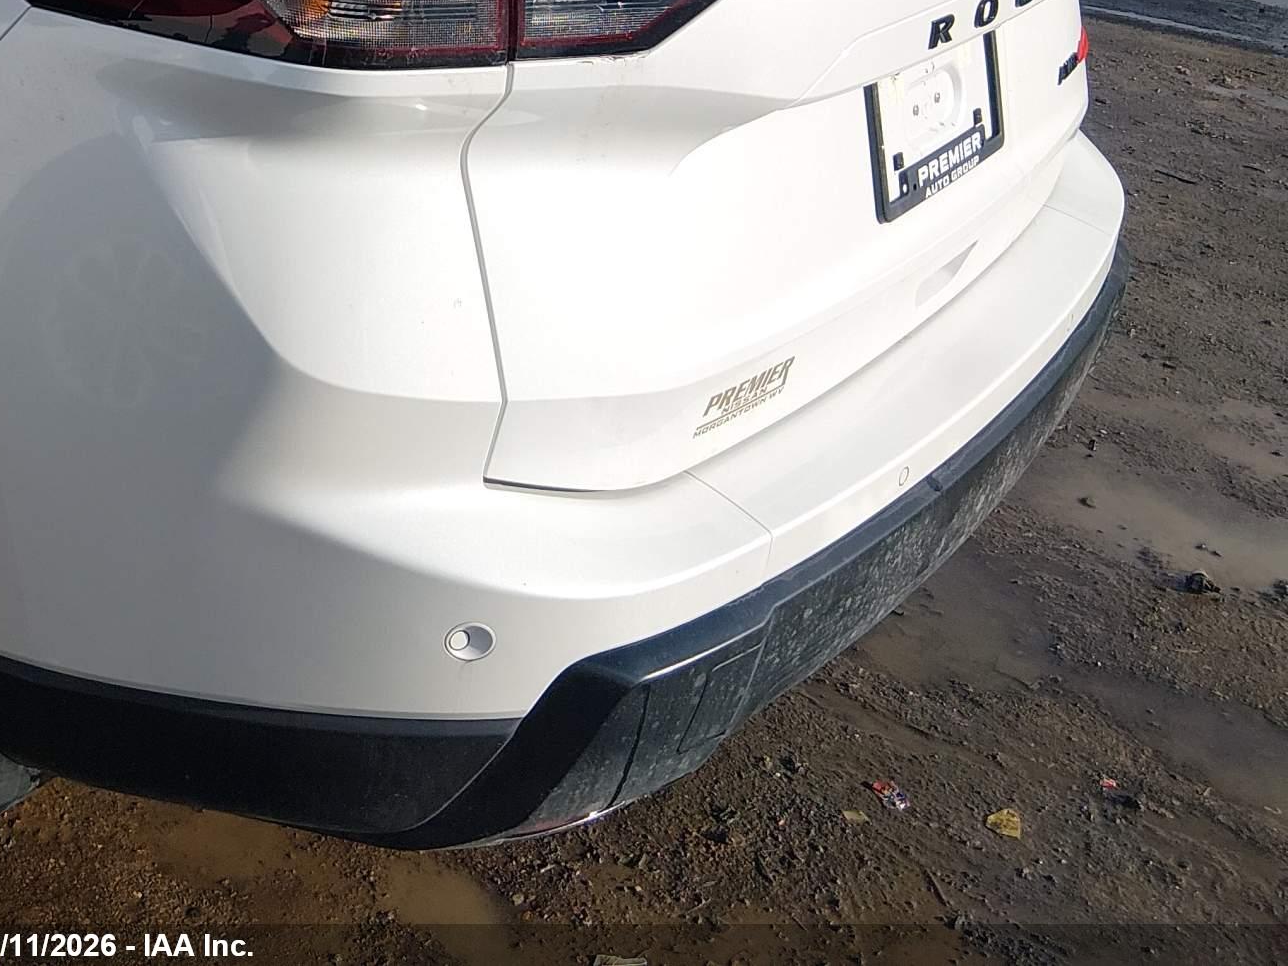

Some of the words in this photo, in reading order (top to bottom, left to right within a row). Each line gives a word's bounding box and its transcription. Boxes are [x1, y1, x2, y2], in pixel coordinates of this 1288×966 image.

[918, 131, 982, 188] PREMIER
[925, 175, 950, 199] AUTO
[951, 155, 980, 182] GROUP
[702, 356, 795, 418] PREMIER
[721, 386, 768, 415] NISSAN
[692, 396, 767, 439] MORGANTOWN
